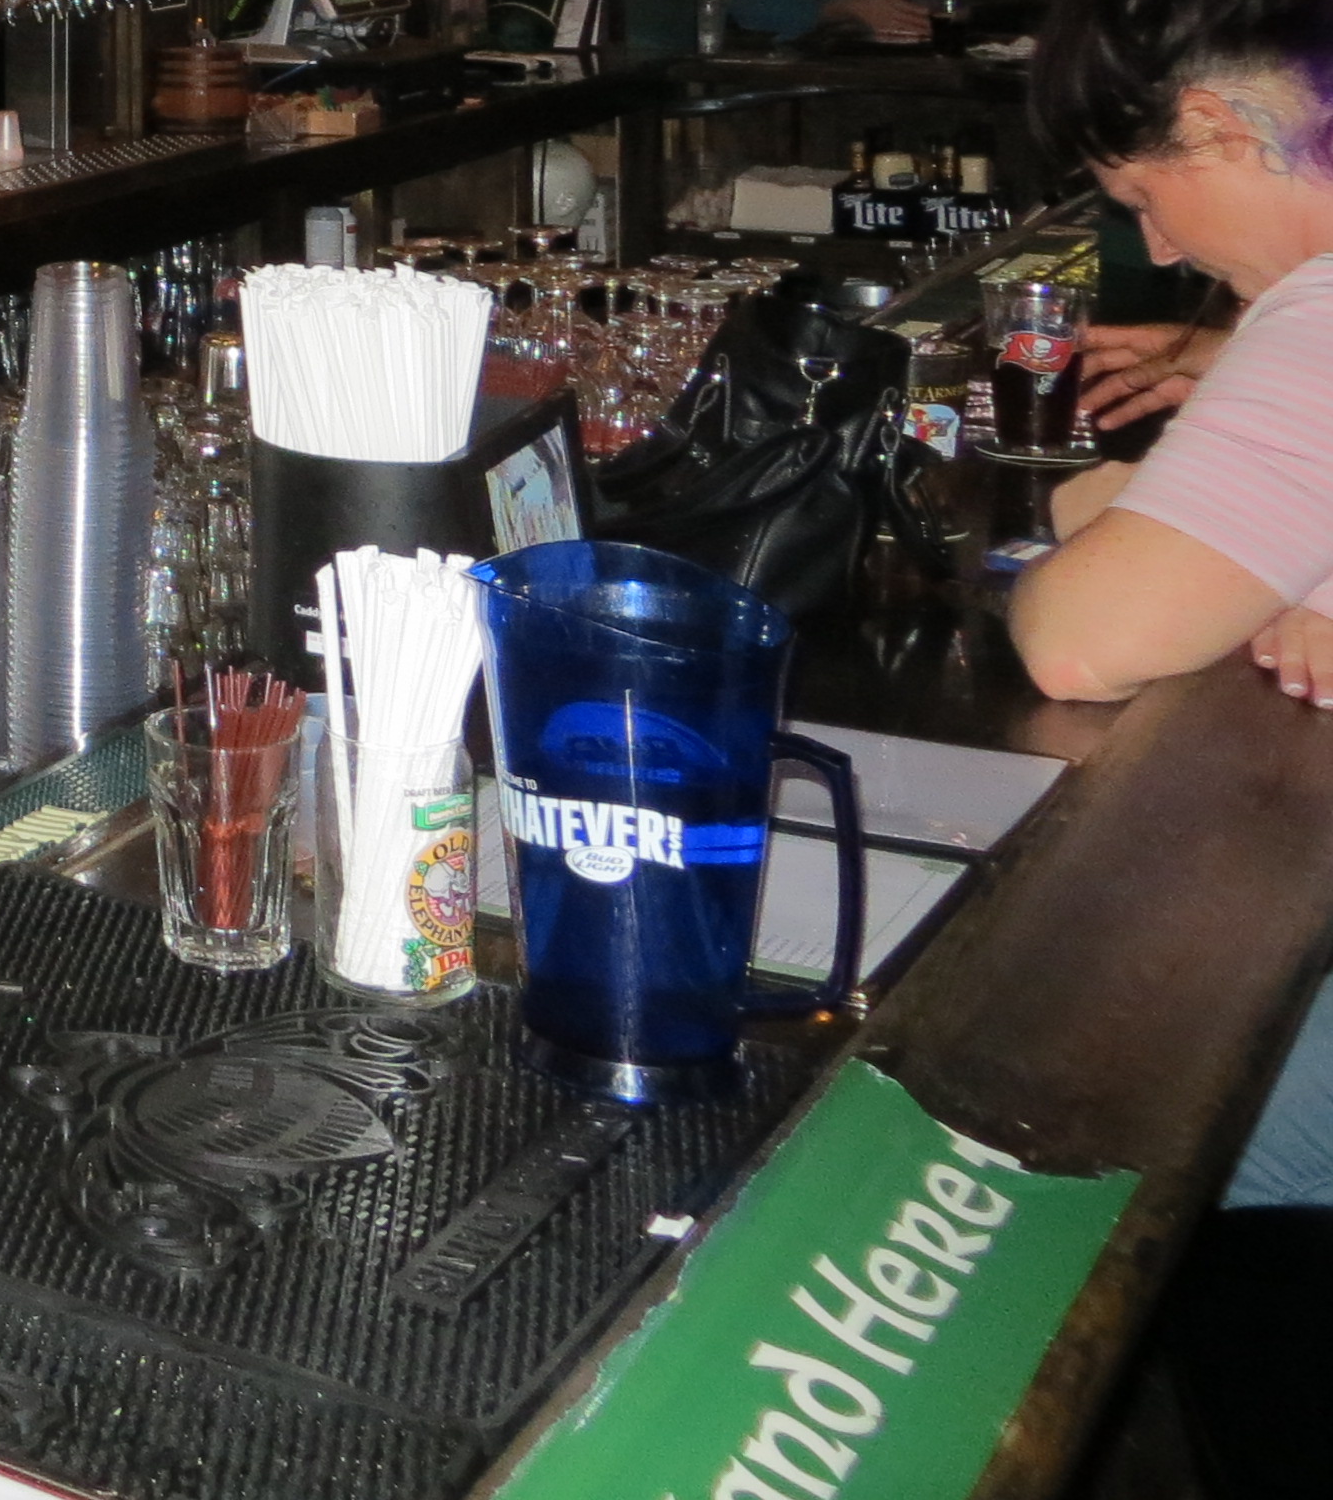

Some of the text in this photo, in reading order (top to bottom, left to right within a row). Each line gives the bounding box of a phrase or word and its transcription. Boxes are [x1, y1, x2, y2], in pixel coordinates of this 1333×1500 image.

[853, 200, 904, 230] Lite
[432, 833, 470, 861] OLD
[666, 814, 685, 870] USA
[576, 860, 629, 876] LIGHT
[583, 851, 624, 865] BUD
[436, 949, 470, 972] IPA
[790, 1162, 1015, 1376] Here
